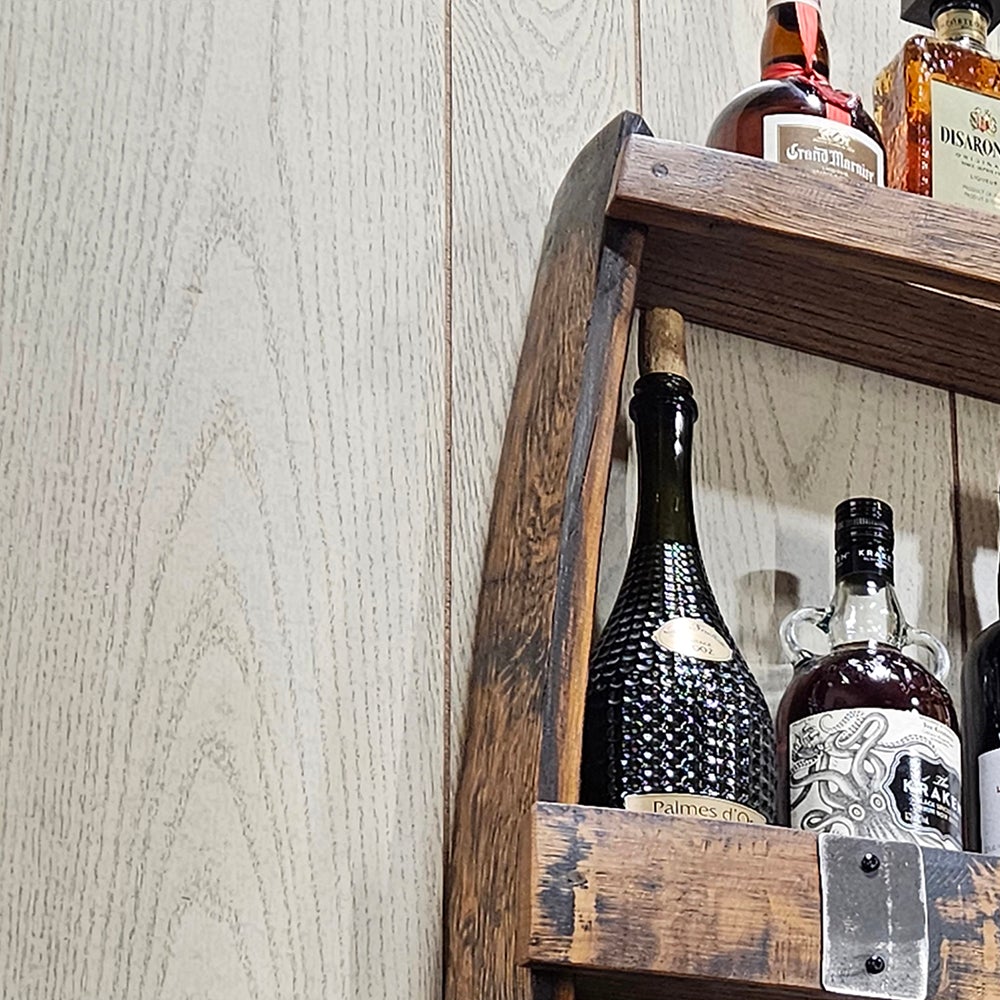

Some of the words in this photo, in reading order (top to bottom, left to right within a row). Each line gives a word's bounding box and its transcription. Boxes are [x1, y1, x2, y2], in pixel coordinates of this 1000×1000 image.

[902, 778, 959, 812] KRAKE
[653, 801, 717, 818] Palmes
[722, 808, 753, 823] d'O
